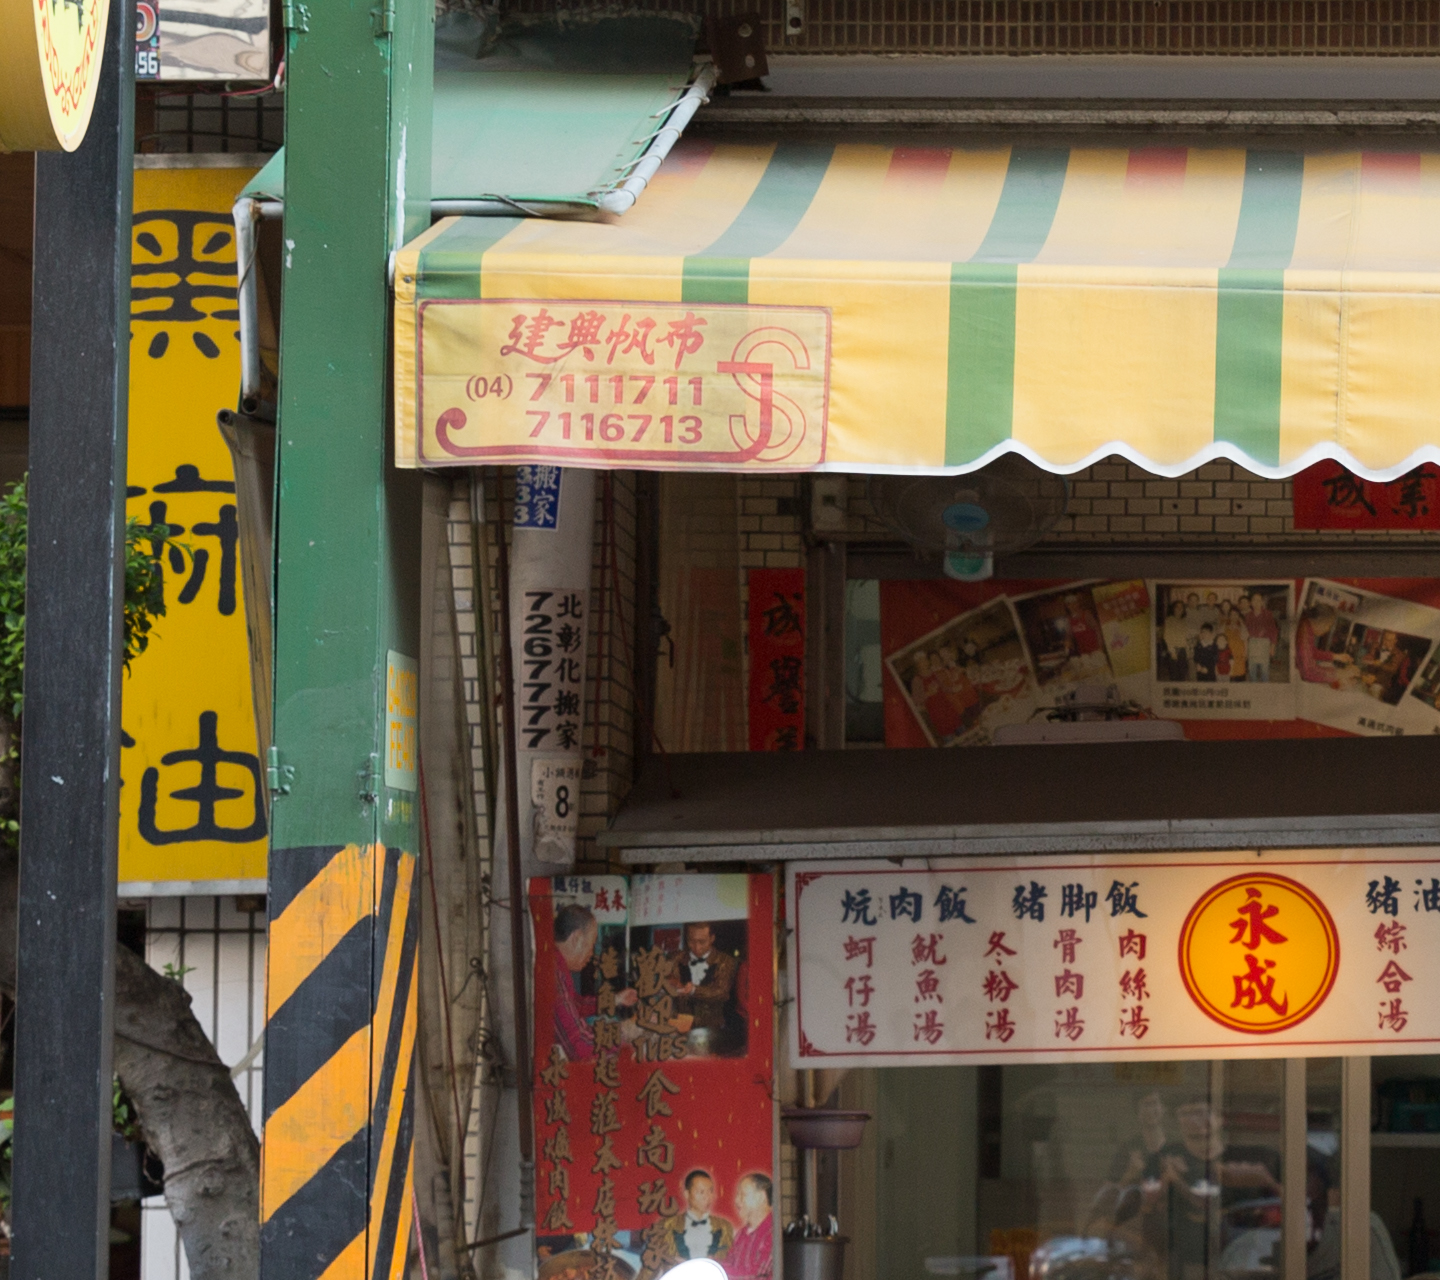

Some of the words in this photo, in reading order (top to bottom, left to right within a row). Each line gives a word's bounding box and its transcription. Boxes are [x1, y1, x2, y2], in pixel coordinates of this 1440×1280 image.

[465, 374, 514, 401] (04)
[525, 373, 704, 407] 7111711
[500, 307, 708, 369] 建興帆布
[525, 410, 704, 444] 7116713
[532, 466, 559, 525] 搬家
[522, 591, 554, 749] 7267777
[553, 594, 584, 751] 北彰化搬家
[842, 934, 878, 1046] 蚵仔湯
[911, 932, 947, 1046] 魷魚湯
[982, 930, 1019, 1043] 冬粉湯
[1052, 929, 1086, 1042] 骨肉湯
[1117, 927, 1152, 1040] 肉絲湯
[1229, 887, 1289, 1016] 永成
[1373, 920, 1414, 1034] 綜合湯
